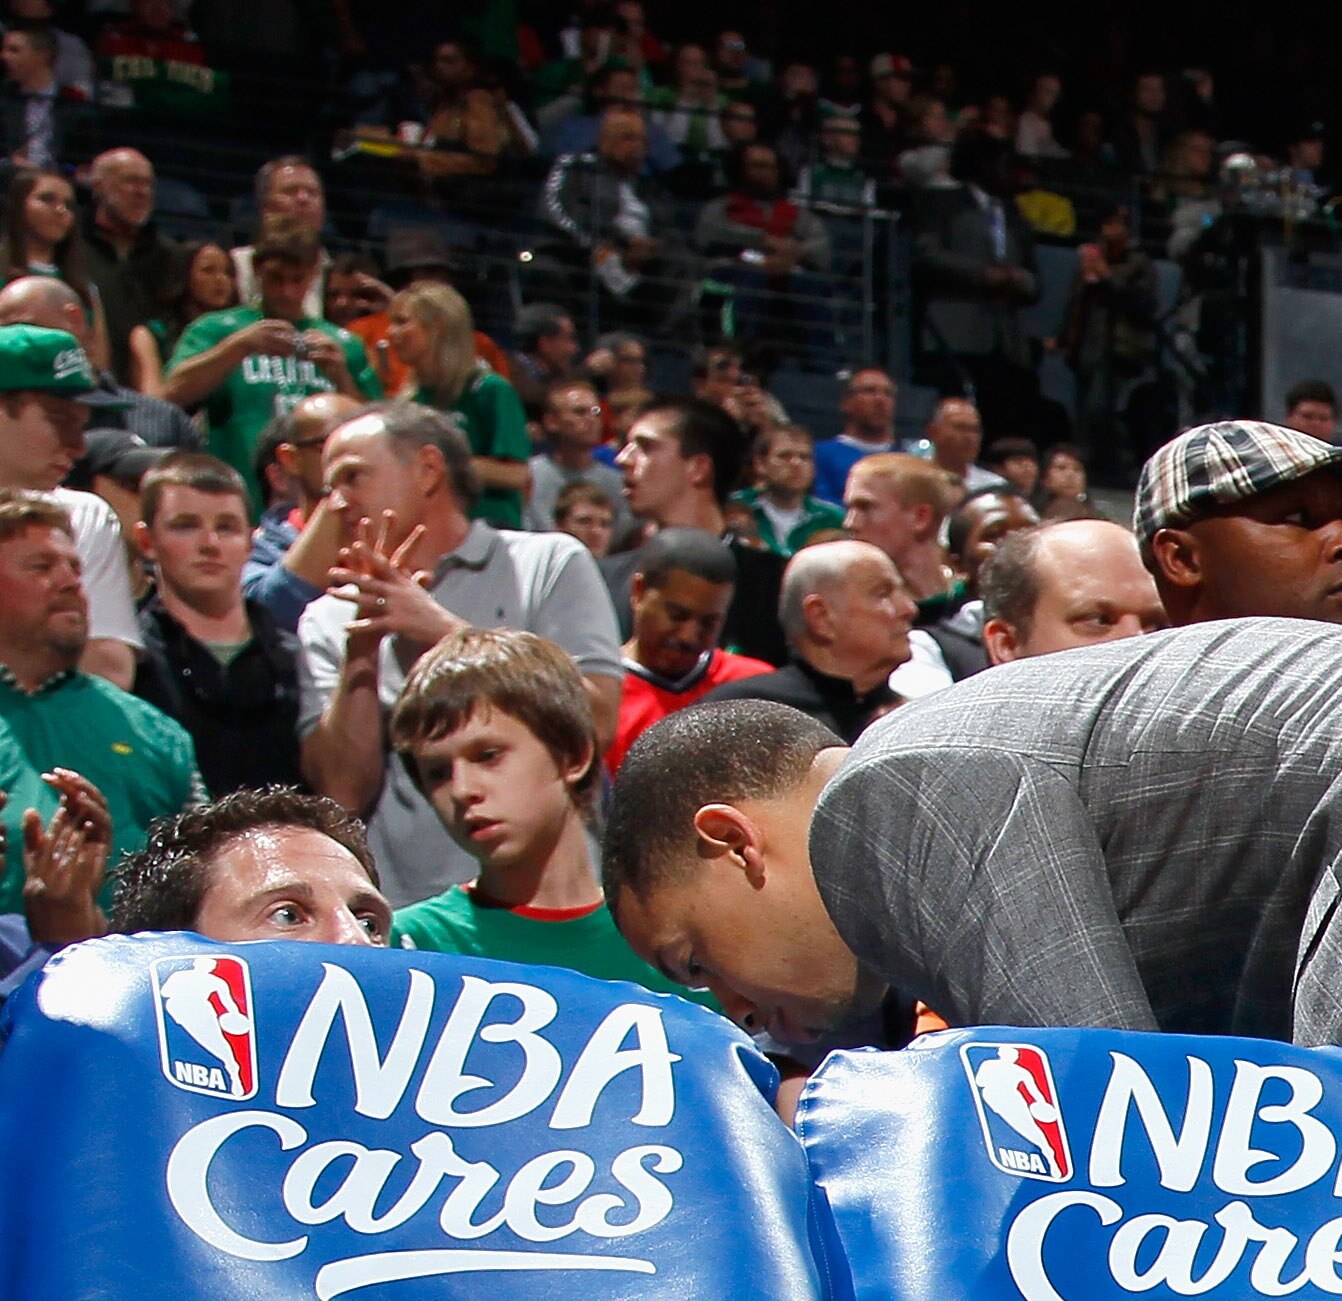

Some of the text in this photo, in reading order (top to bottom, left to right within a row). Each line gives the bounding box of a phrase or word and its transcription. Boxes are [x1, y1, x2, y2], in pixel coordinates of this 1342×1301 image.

[174, 1060, 227, 1091] NBA
[275, 962, 682, 1130] NBA
[166, 1109, 684, 1262] Cares
[998, 1147, 1047, 1174] NBA
